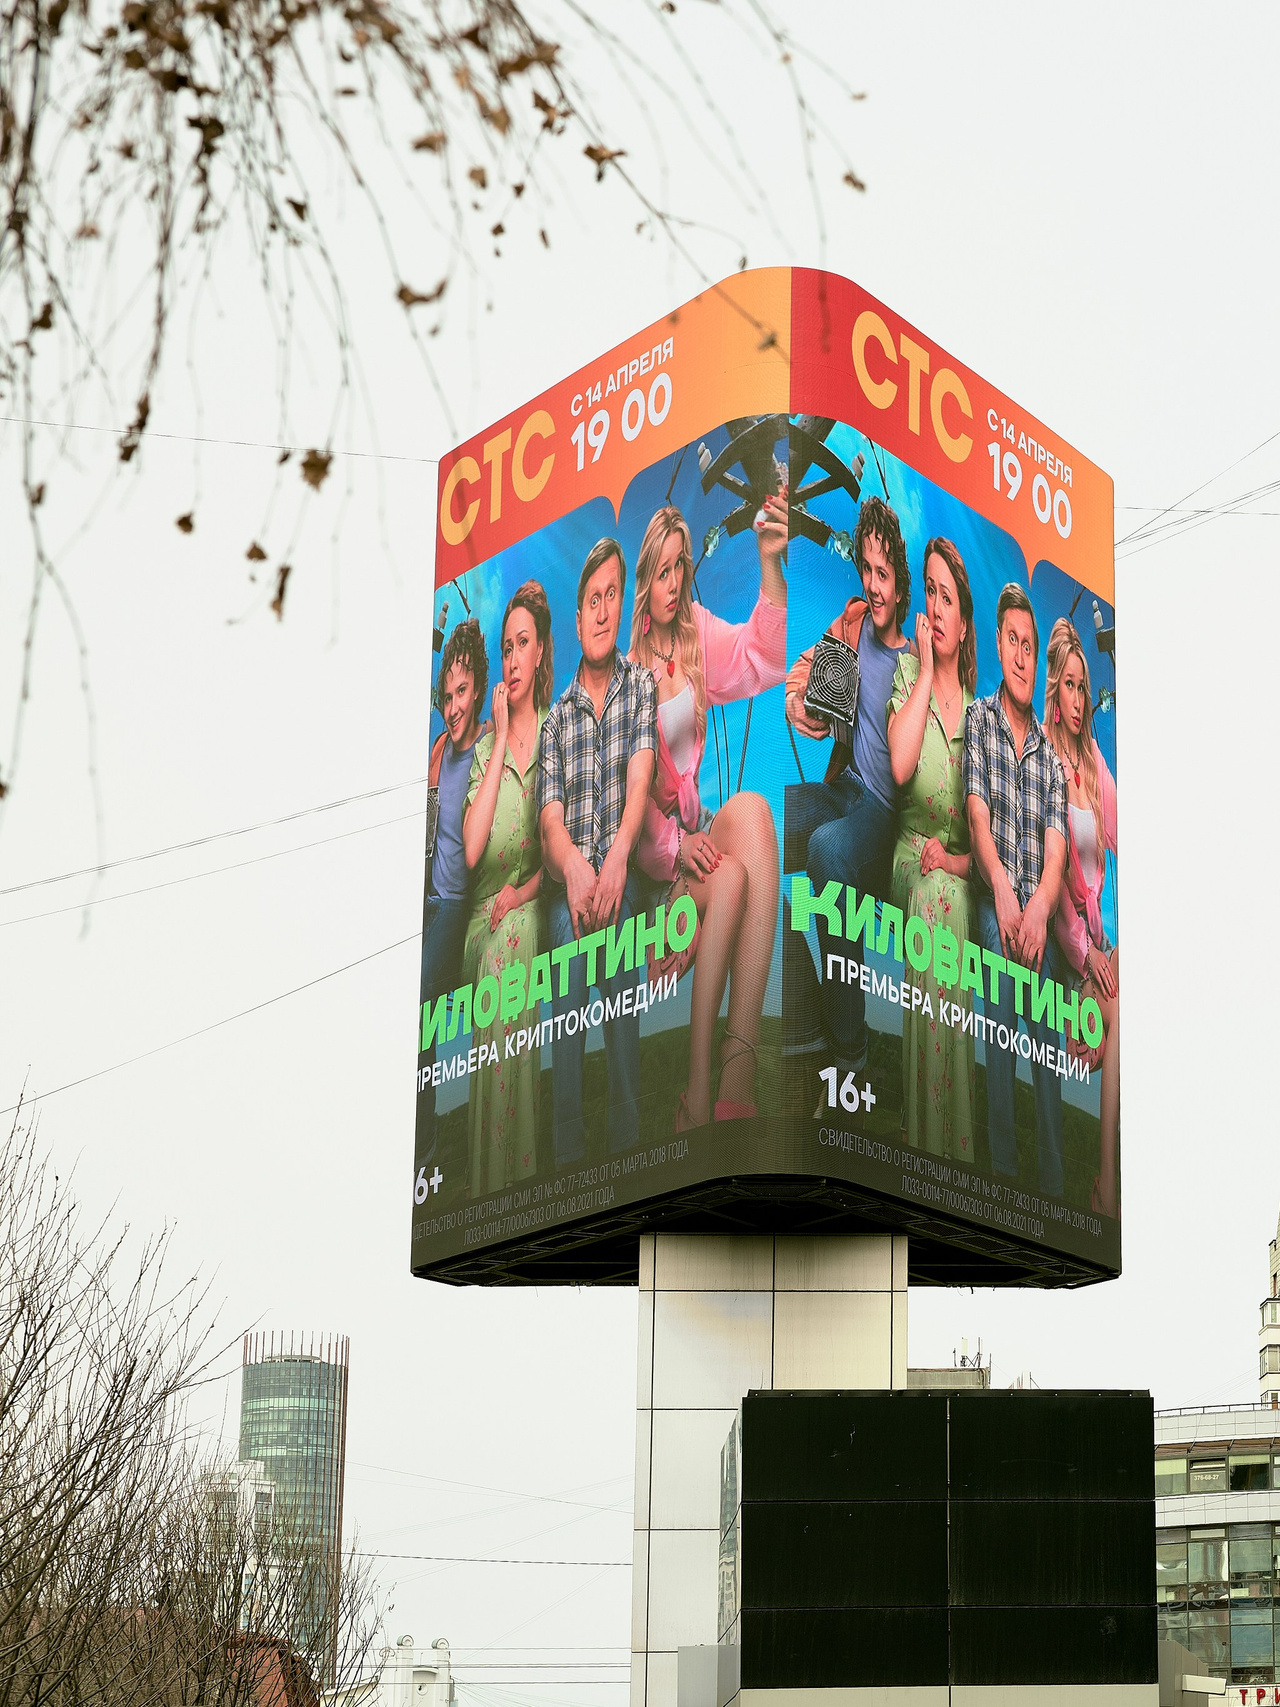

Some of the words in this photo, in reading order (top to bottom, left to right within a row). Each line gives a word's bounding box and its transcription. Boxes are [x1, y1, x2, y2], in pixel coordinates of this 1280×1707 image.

[570, 394, 583, 417] С
[585, 381, 602, 408] 14
[604, 337, 674, 392] АПРЕЛЯ
[570, 409, 610, 472] 19
[621, 372, 672, 442] 00
[852, 311, 973, 463] СТС
[440, 410, 556, 545] СТС
[987, 408, 999, 431] С
[1000, 417, 1016, 444] 14
[1017, 431, 1073, 488] АПРЕЛЯ
[987, 441, 1022, 501] 19
[1032, 473, 1072, 539] 00
[418, 894, 697, 1054] ИЛОВАТТИНО
[504, 971, 678, 1060] КРИПТОКОМЕДИИ
[827, 954, 933, 1019] ПРЕМЬЕРА
[939, 1000, 1090, 1085] КРИПТОКОМЕДИИ
[818, 1066, 876, 1113] 16+
[464, 1195, 512, 1223] РЕГИСТРАЦИИ
[513, 1189, 531, 1209] СМИ
[554, 1178, 565, 1195] ФС
[567, 1167, 598, 1192] 77-72433
[600, 1163, 609, 1182] ОТ
[622, 1152, 648, 1175] МАРТА
[649, 1146, 666, 1167] 2018
[668, 1139, 689, 1161] ГОДА
[546, 1203, 556, 1221] ОТ
[595, 1186, 615, 1206] ГОДА
[818, 1127, 892, 1164] СВИДЕТЕЛЬСТВО
[894, 1149, 900, 1166] О
[901, 1152, 951, 1184] РЕГИСТРАЦИИ
[952, 1169, 970, 1190] СМИ
[991, 1184, 1002, 1201] ФС
[1003, 1186, 1030, 1211] 77-72433
[1031, 1197, 1039, 1214] ОТ
[1050, 1203, 1072, 1226] МАРТА
[1072, 1211, 1085, 1230] 2018
[1086, 1216, 1103, 1238] ГОДА
[983, 1202, 993, 1220] ОТ
[1028, 1217, 1045, 1239] ГОДА
